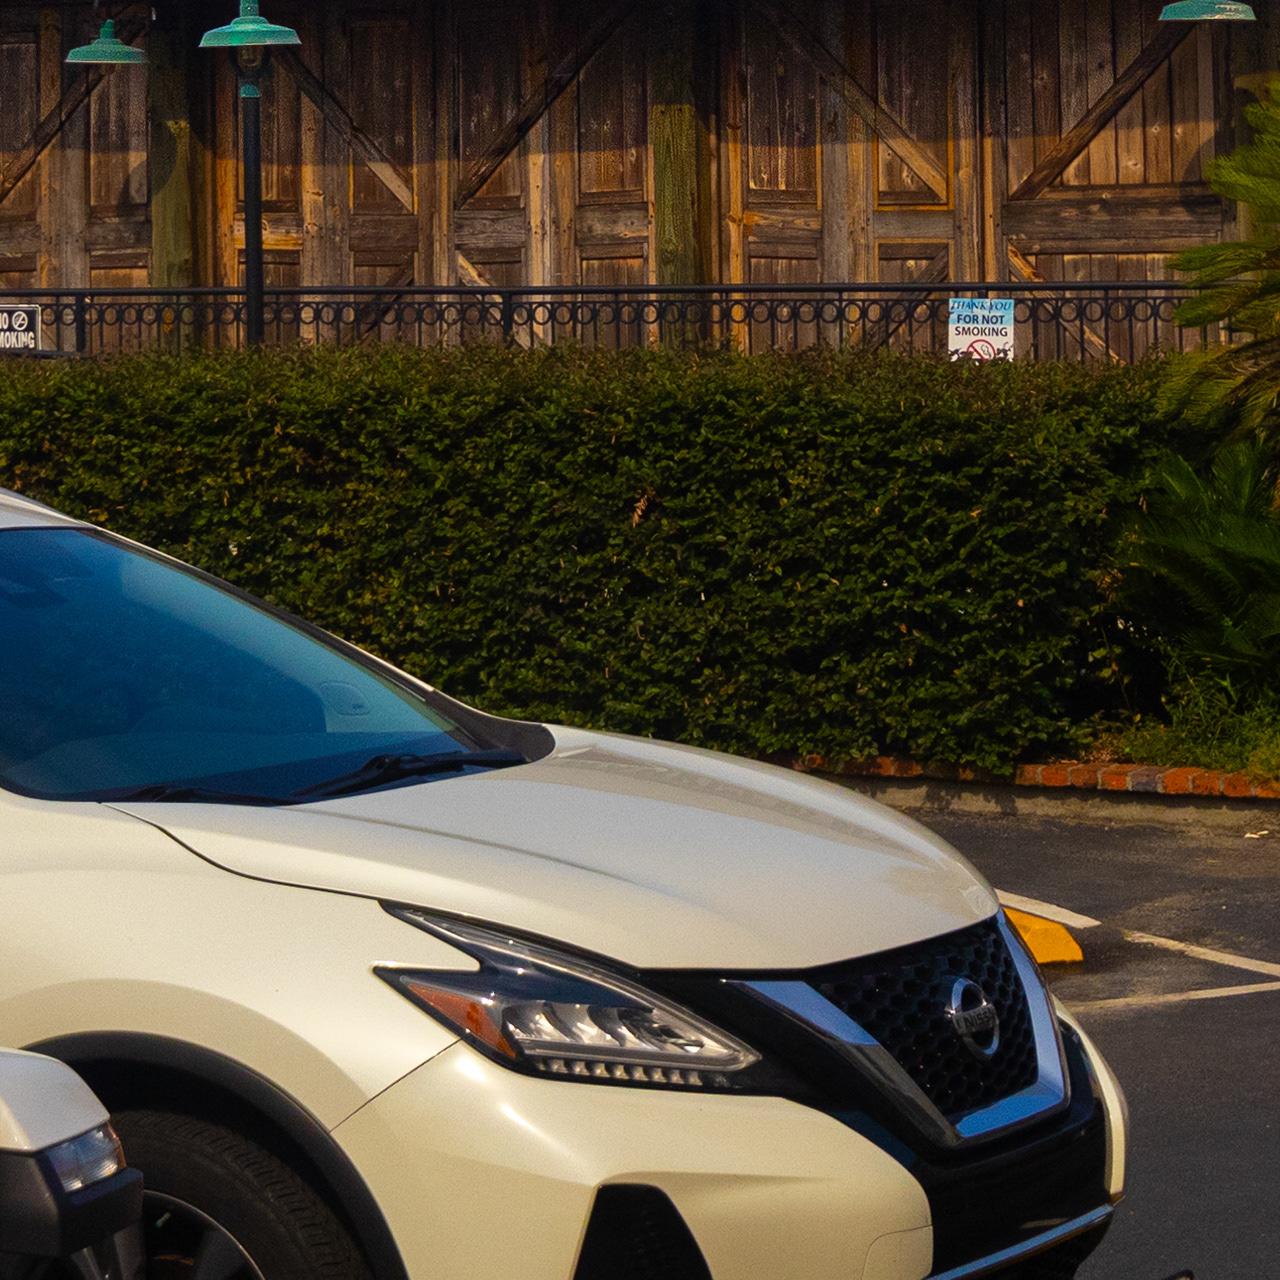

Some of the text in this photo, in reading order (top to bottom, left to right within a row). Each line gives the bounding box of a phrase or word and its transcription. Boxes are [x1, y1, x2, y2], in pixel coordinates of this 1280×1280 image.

[950, 299, 1012, 314] THANK YOU
[957, 314, 1005, 325] FOR NOT
[954, 326, 1008, 337] SMOKING
